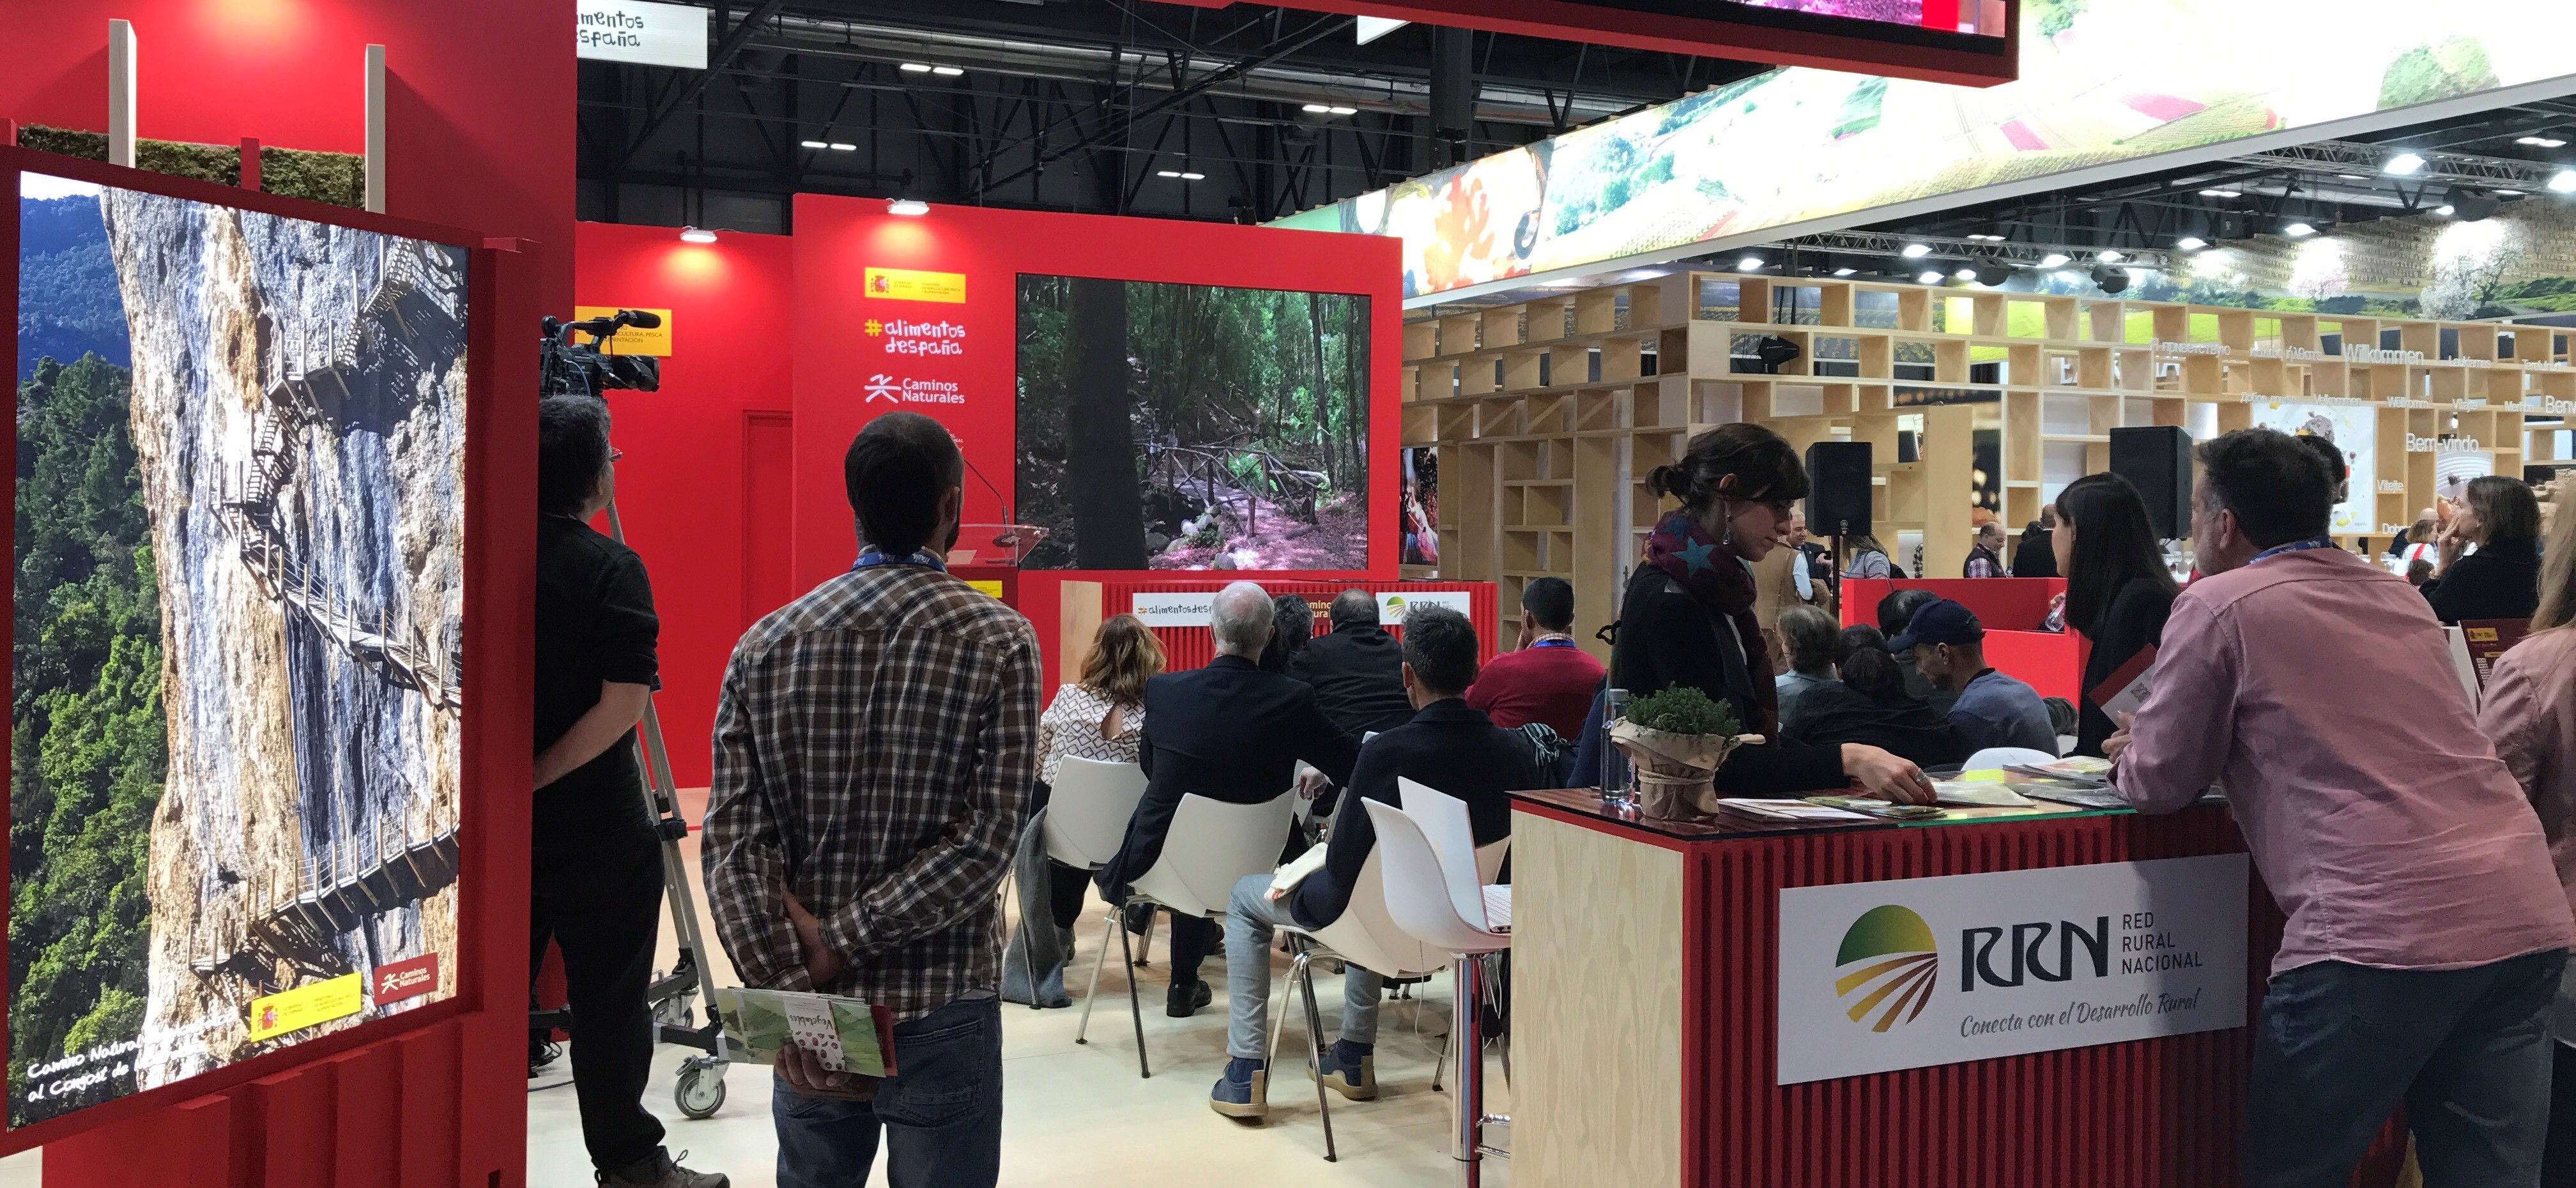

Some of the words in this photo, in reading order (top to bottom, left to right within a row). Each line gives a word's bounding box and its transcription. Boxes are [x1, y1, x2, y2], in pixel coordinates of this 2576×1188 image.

[577, 29, 641, 47] spaña
[865, 319, 966, 338] #alimentos
[885, 337, 963, 356] despaña
[2341, 343, 2425, 366] Willkommen
[903, 377, 958, 391] Caminos
[902, 390, 965, 404] Naturales
[2406, 433, 2479, 452] Bem-vindo
[2122, 912, 2154, 930] RED
[2122, 932, 2175, 952] RURAL
[1962, 916, 2109, 992] RRN
[2122, 951, 2203, 975] NACIONAL
[399, 967, 427, 980] Caminos
[399, 973, 430, 987] Naturales
[1961, 1014, 2022, 1037] Conecta
[2028, 1014, 2055, 1029] con
[2059, 1001, 2075, 1024] el
[2077, 993, 2154, 1023] Desarrollo
[2158, 987, 2200, 1014] Rural
[789, 1014, 834, 1030] Vegetables
[27, 1054, 85, 1078] Camino
[90, 1033, 142, 1062] Natural
[27, 1083, 44, 1102] al
[50, 1066, 107, 1095] Congost
[112, 1061, 129, 1078] de
